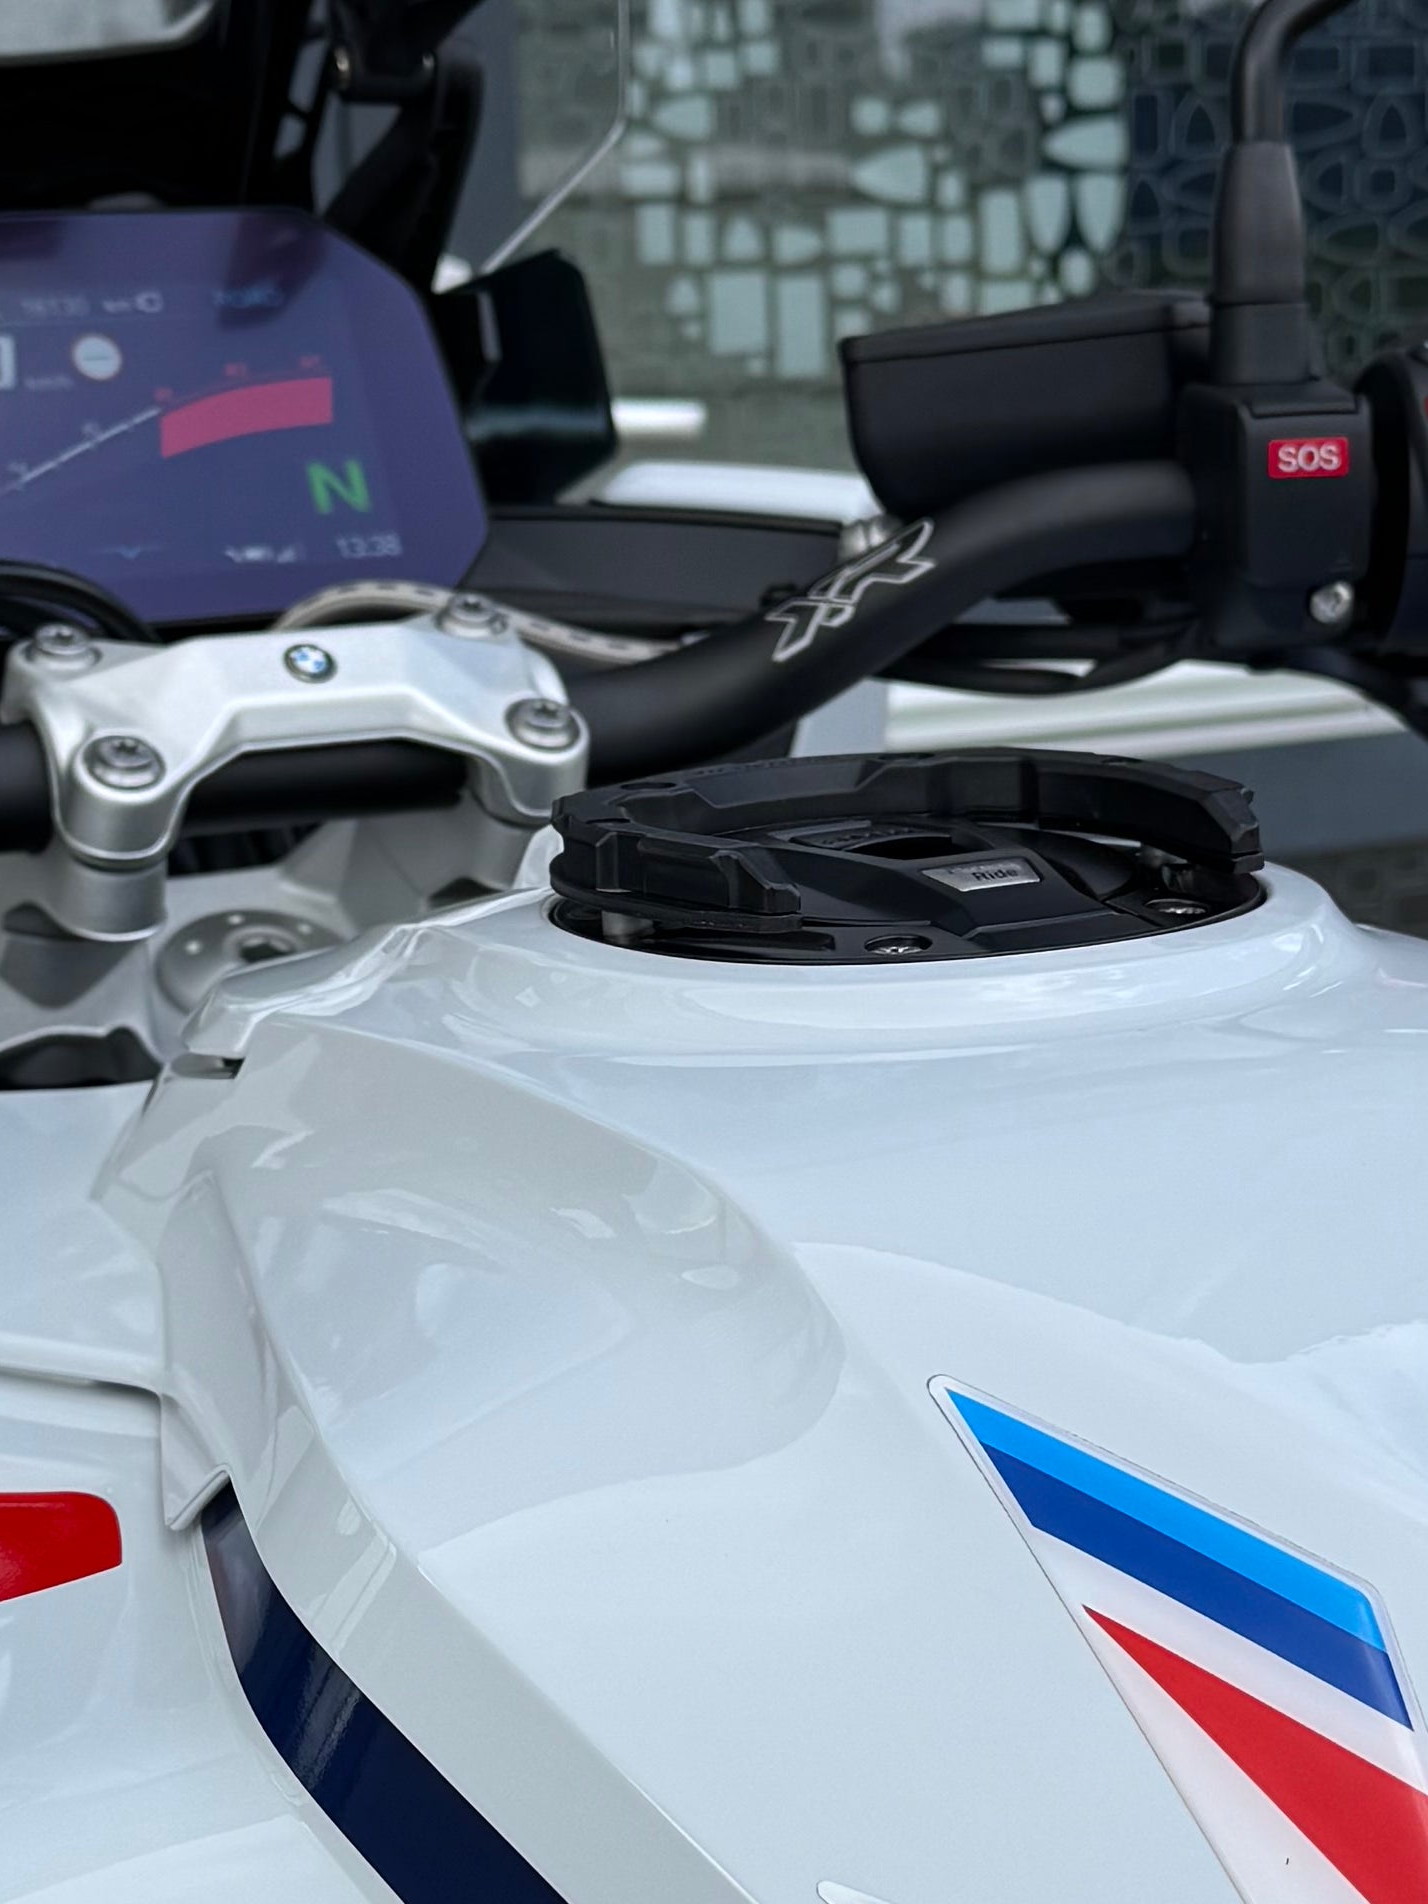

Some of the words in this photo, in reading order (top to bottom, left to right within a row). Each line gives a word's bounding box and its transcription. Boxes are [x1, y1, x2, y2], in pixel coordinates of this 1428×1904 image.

[1278, 443, 1342, 473] SOS
[306, 456, 373, 516] N
[971, 869, 1018, 881] Ride
